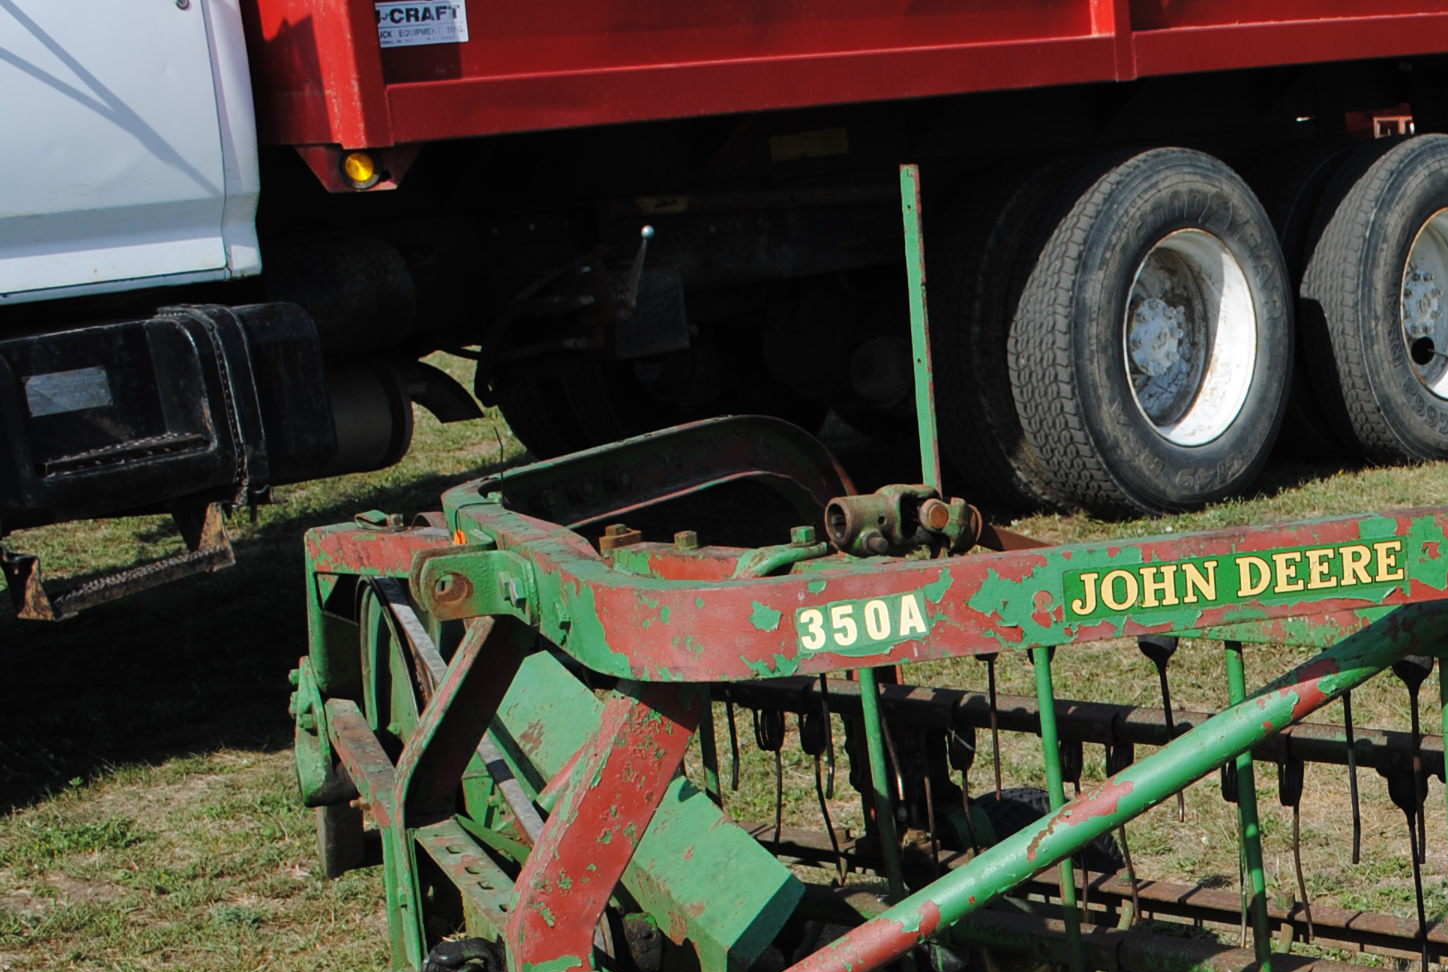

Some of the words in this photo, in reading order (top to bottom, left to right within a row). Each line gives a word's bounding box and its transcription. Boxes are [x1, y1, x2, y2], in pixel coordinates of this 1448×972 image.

[1071, 560, 1218, 616] JOHN
[1235, 540, 1405, 598] DEERE
[800, 594, 927, 650] 350A
